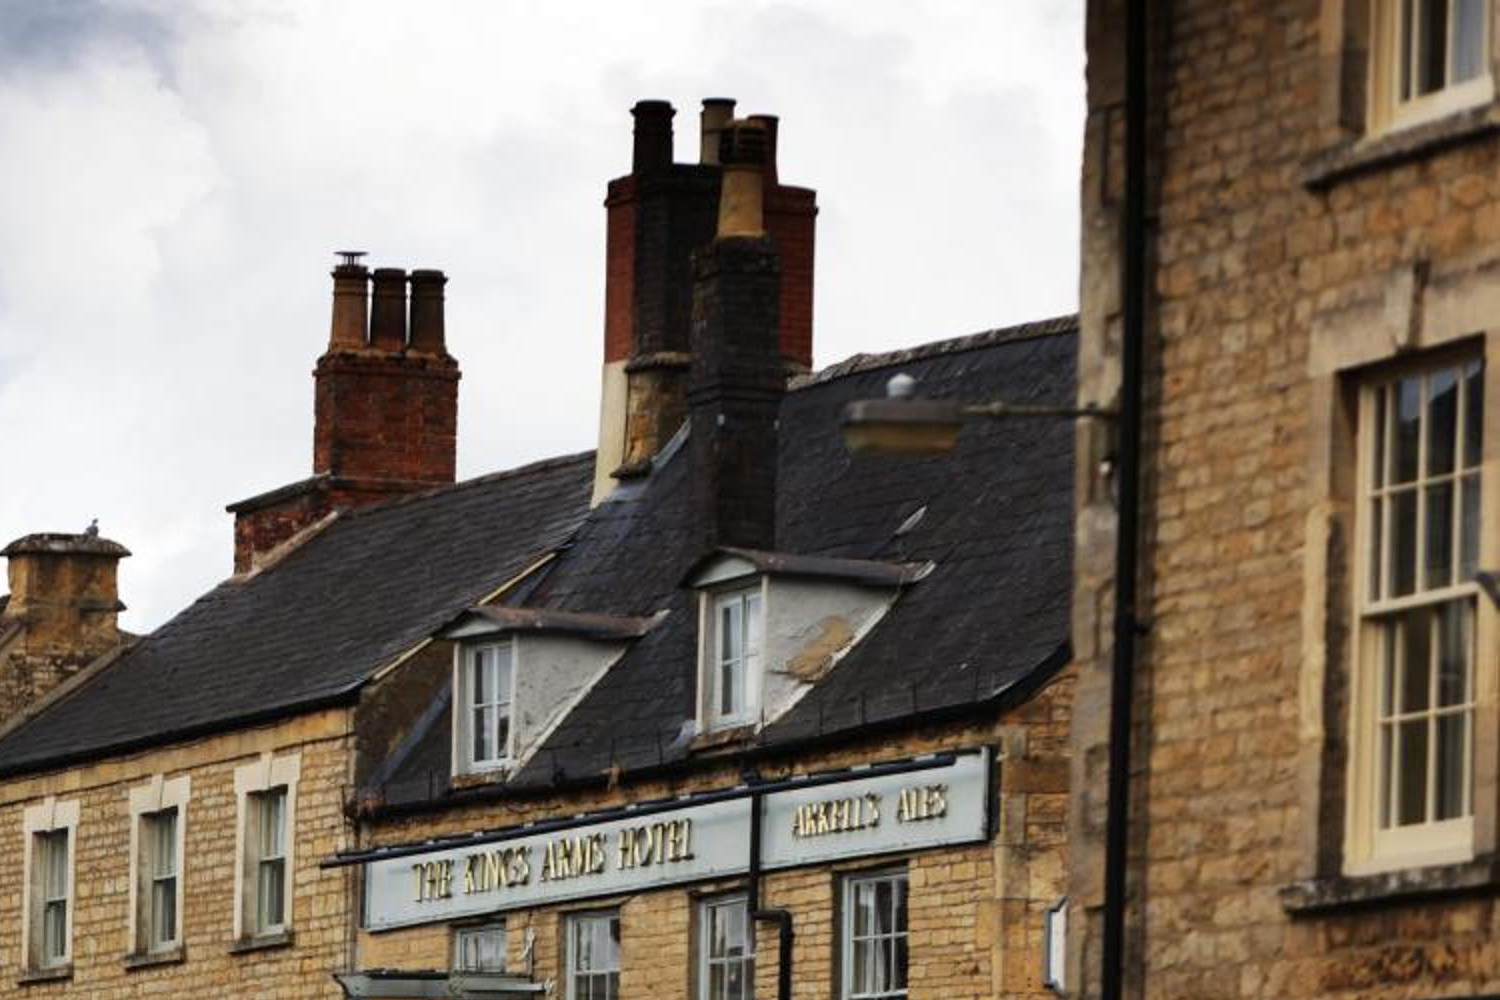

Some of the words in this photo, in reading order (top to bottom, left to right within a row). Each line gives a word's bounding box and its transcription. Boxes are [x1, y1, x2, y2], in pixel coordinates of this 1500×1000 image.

[897, 784, 949, 823] ALES
[412, 860, 453, 903] THE
[541, 834, 607, 882] ARMS
[618, 818, 695, 871] HOTEL
